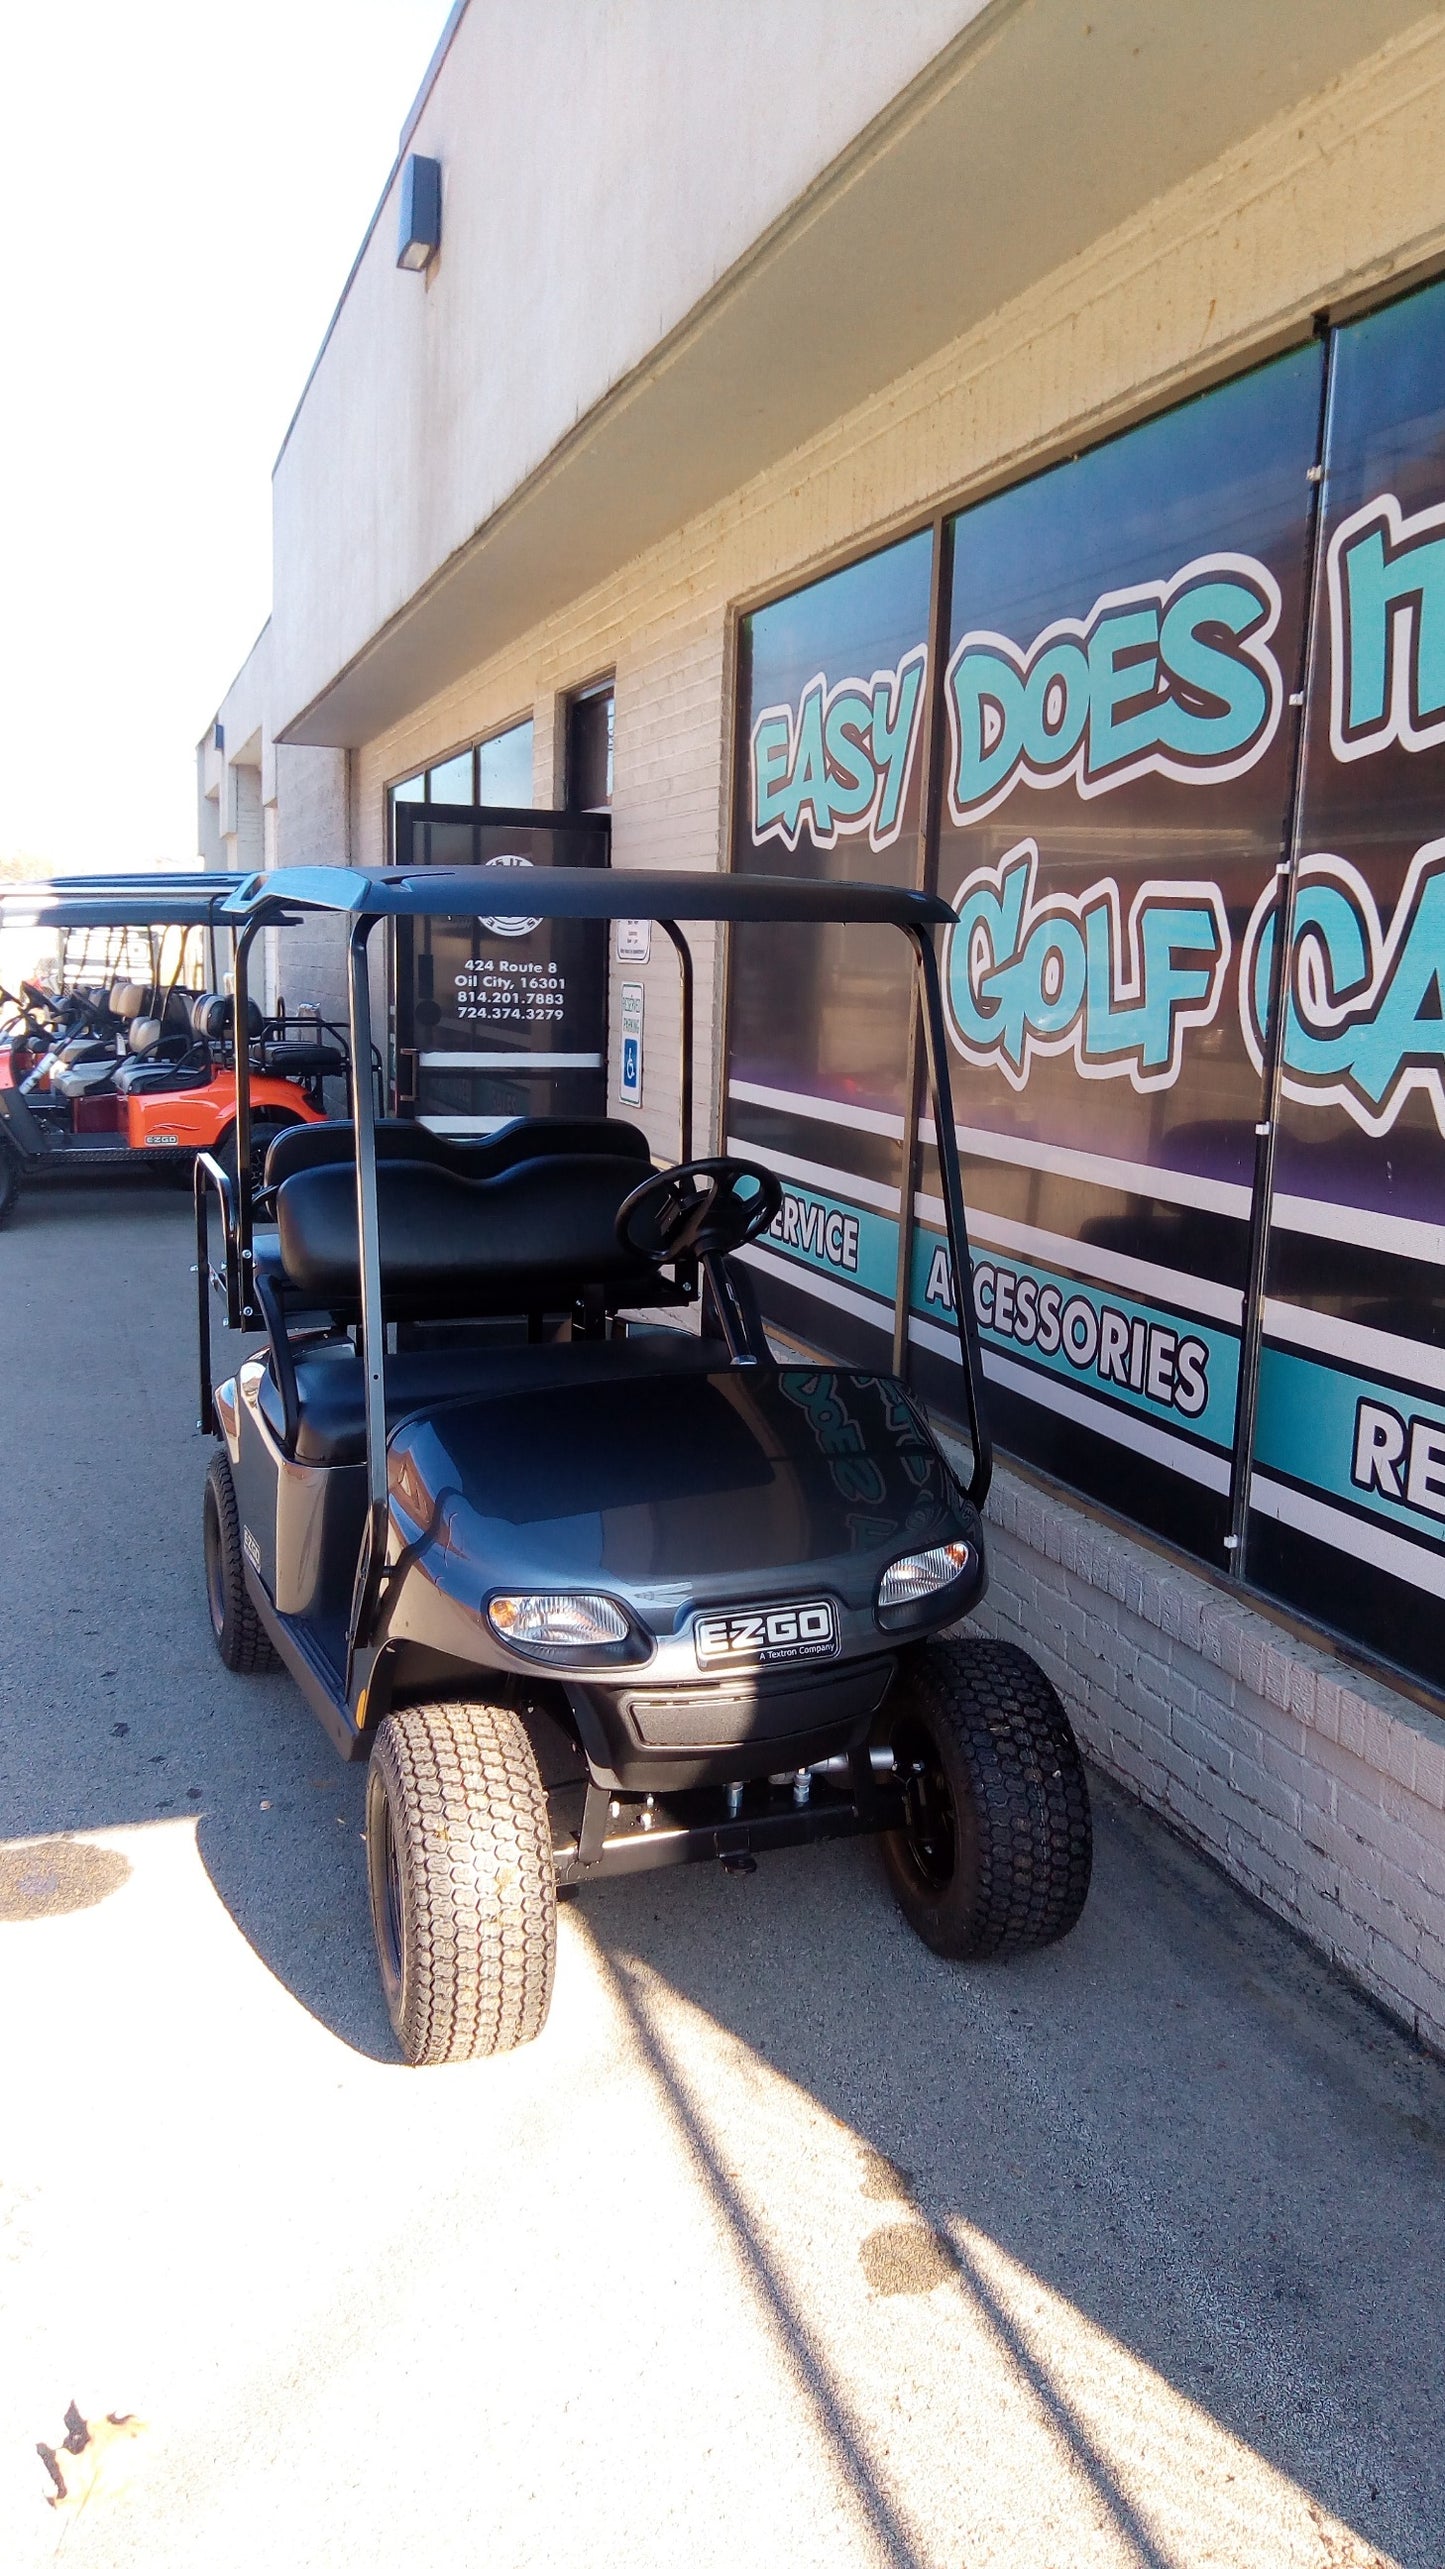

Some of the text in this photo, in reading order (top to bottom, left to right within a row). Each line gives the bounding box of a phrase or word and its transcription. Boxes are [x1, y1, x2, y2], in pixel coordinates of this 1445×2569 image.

[751, 642, 929, 854] EASY
[946, 552, 1283, 826] DOES
[464, 959, 558, 974] 424 Route 8
[942, 838, 1231, 1093] GOLF
[454, 974, 566, 991] Oil City, 16301
[457, 991, 564, 1005] 814.201.7883
[457, 1006, 564, 1021] 724.374.3279
[761, 1193, 860, 1274] ERVICE
[924, 1245, 1210, 1418] ACESSORIES
[759, 1643, 835, 1661] A Textron Company
